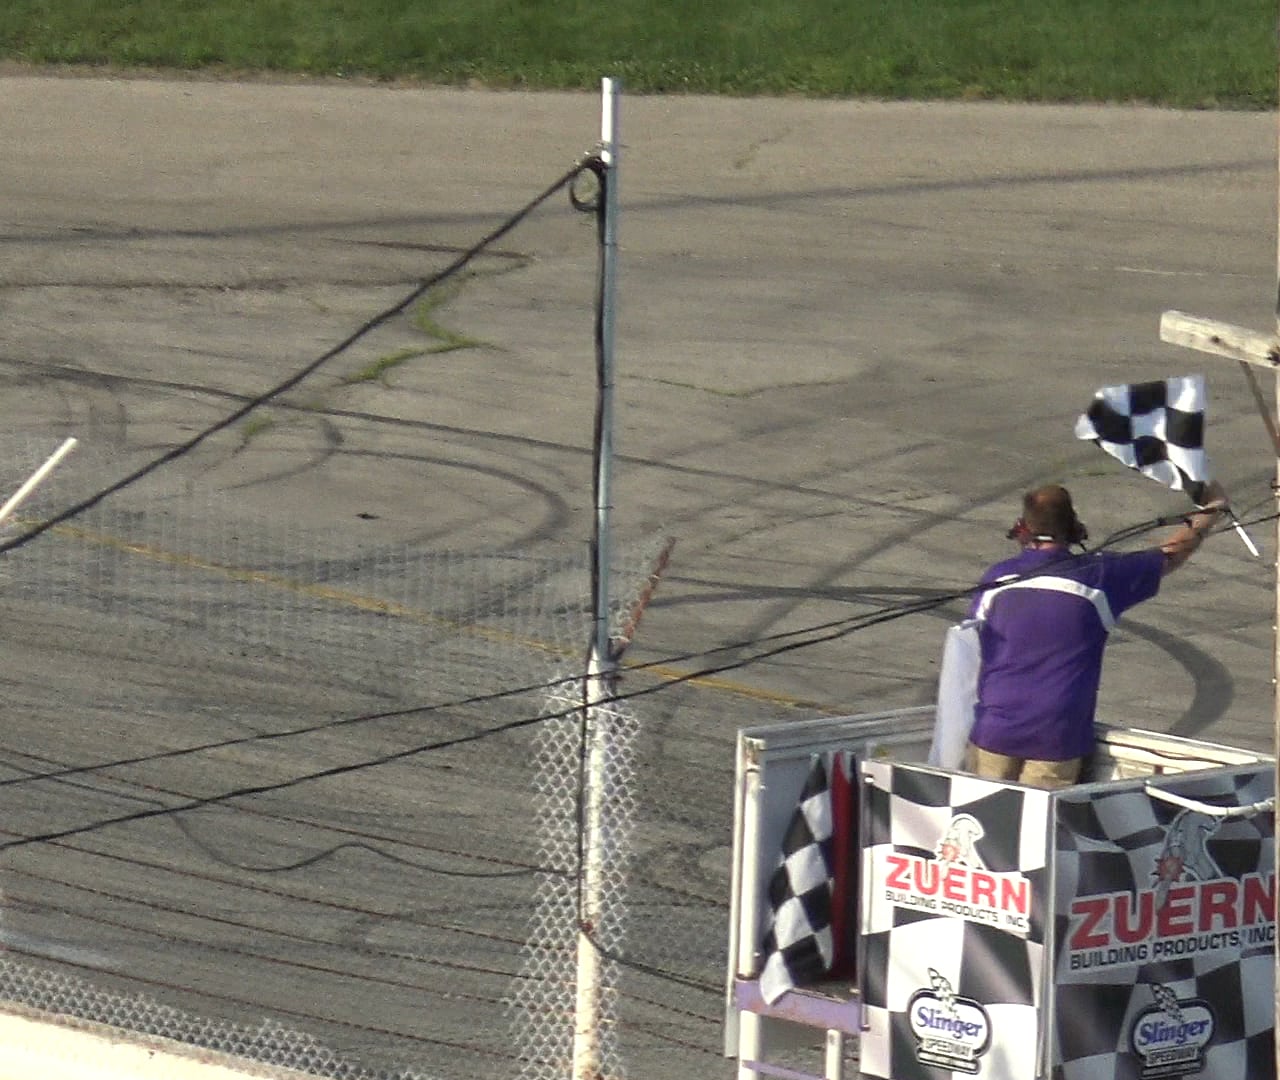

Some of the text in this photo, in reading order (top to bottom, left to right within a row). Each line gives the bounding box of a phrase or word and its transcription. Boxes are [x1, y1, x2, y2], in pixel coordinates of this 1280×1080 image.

[886, 855, 1026, 914] ZUERN
[886, 890, 937, 910] BUILDING
[1070, 875, 1275, 950] ZUERN
[1070, 944, 1148, 970] BUILDING
[916, 1006, 983, 1039] Slinger
[1138, 1019, 1210, 1046] Slinger
